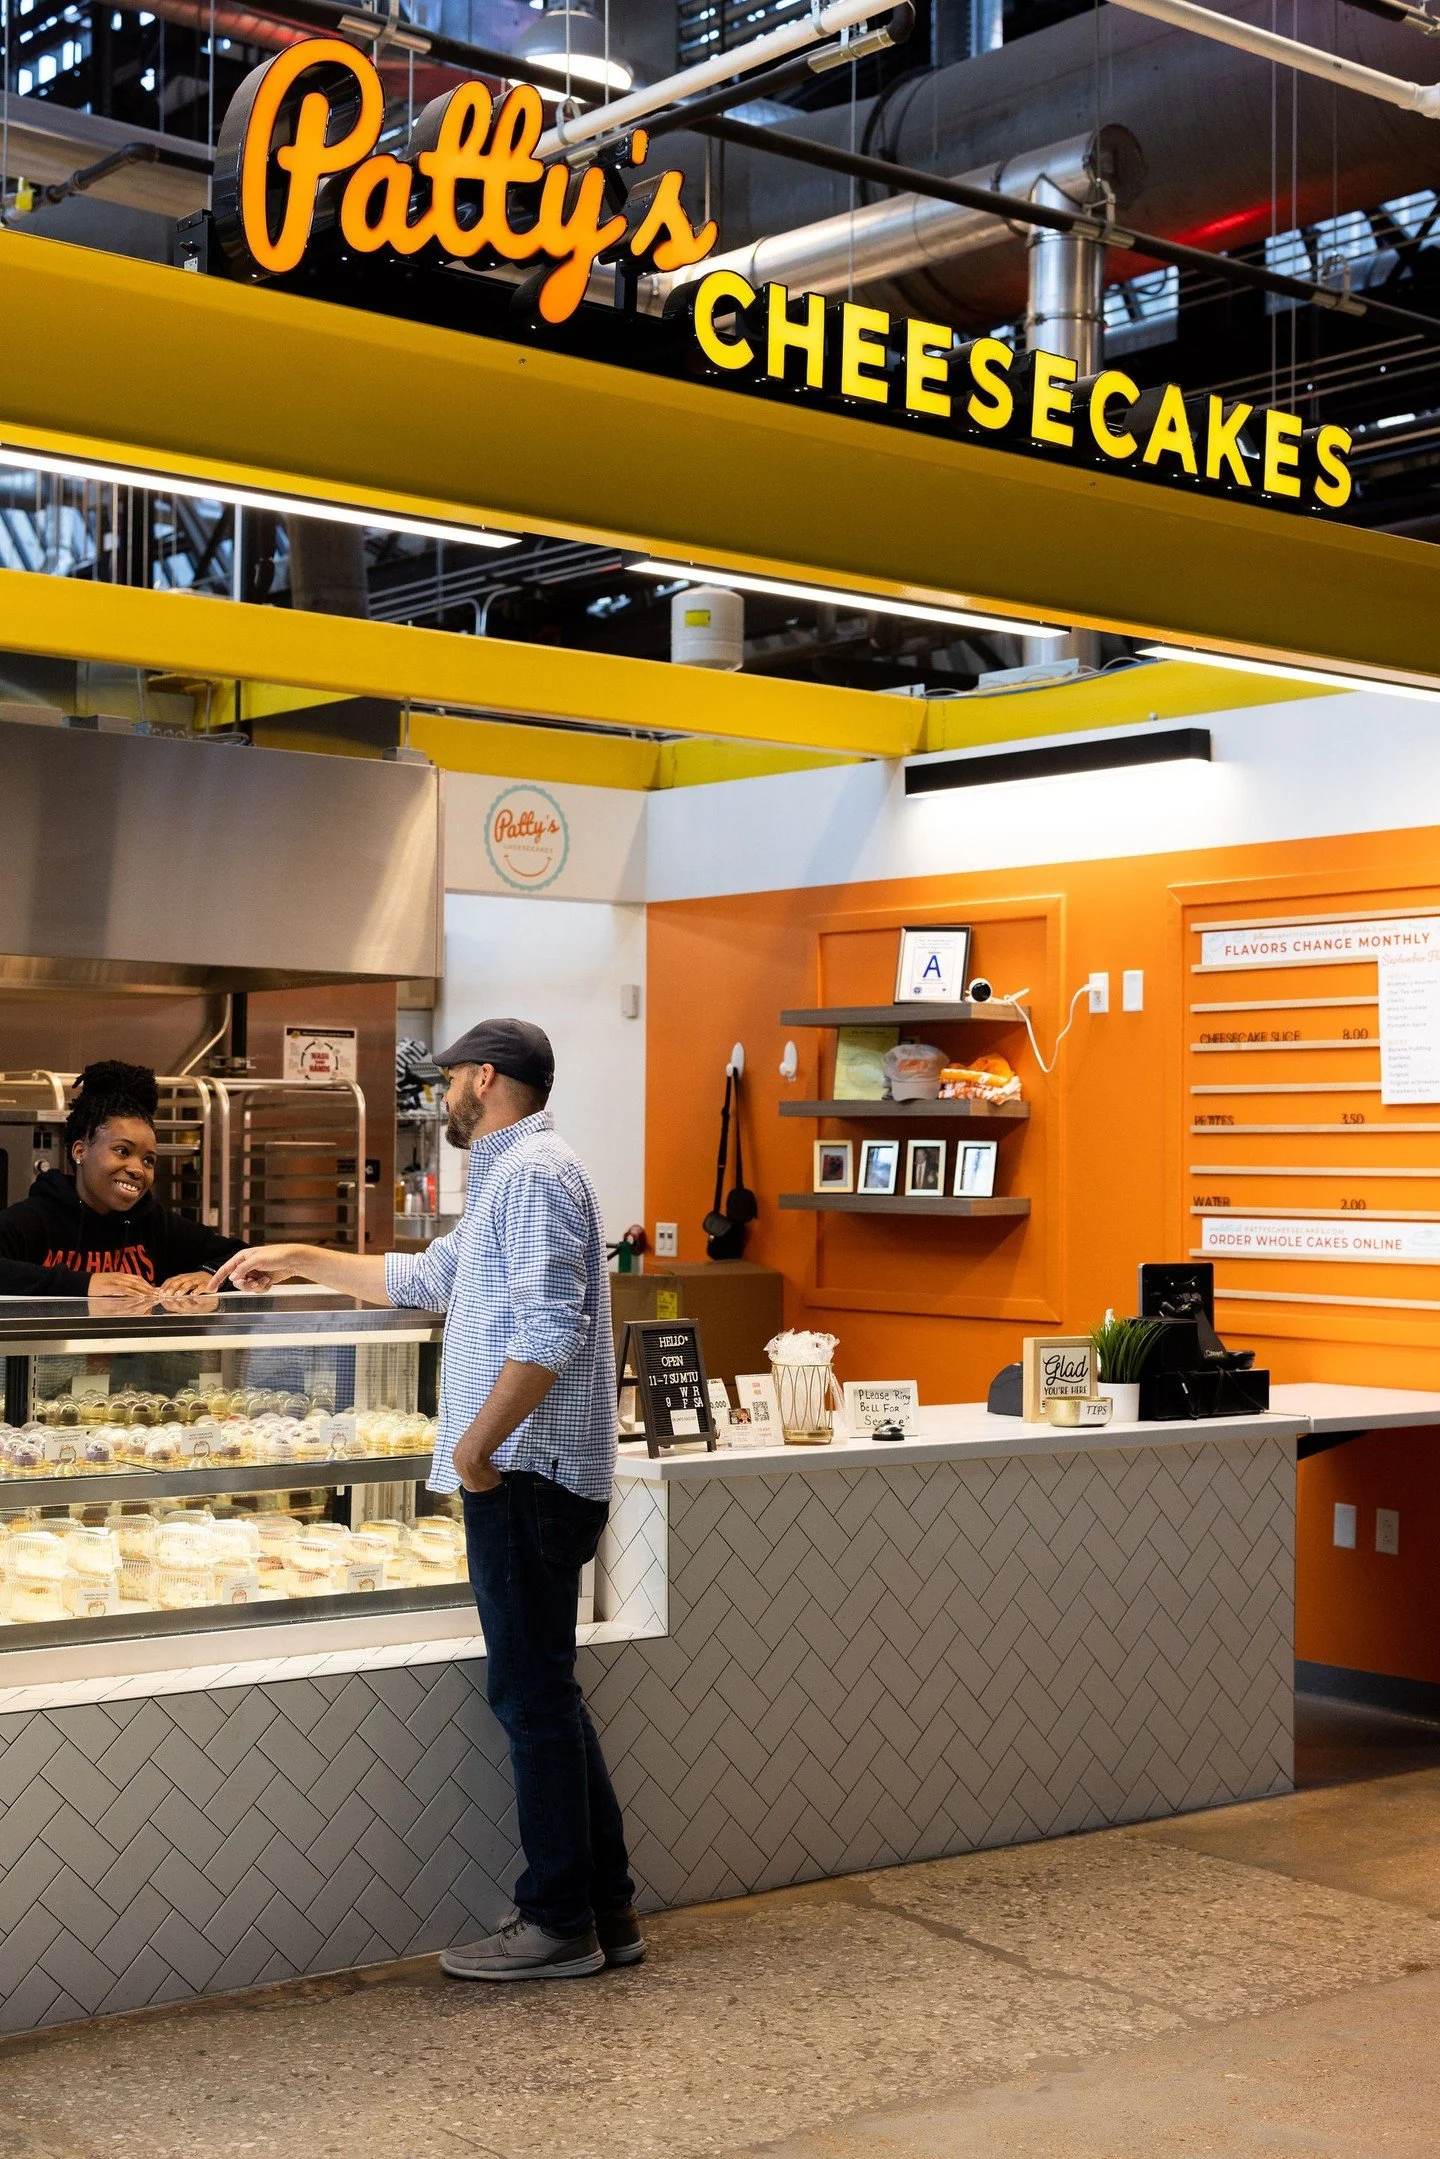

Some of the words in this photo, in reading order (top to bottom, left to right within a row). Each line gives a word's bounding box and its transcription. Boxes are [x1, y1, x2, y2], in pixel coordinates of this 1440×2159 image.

[241, 36, 719, 325] Patty's
[693, 268, 1353, 509] CHEESECAKES
[494, 808, 560, 844] Patty's
[1224, 942, 1288, 957] FLAVORS
[1293, 937, 1352, 952] CHANGE
[1358, 933, 1430, 948] MONTHLY
[922, 955, 942, 978] A
[1200, 1031, 1267, 1044] CHEESECAKE
[1270, 1030, 1302, 1042] SLICE
[1343, 1028, 1369, 1040] 8.00
[1194, 1115, 1235, 1126] PETITES
[1341, 1113, 1365, 1125] 3.50
[1193, 1195, 1231, 1207] WATER
[1340, 1198, 1366, 1211] 2.00
[1209, 1233, 1252, 1245] ORDER
[1256, 1235, 1302, 1247] WHOLE
[1306, 1236, 1349, 1249] CAKES
[1354, 1238, 1403, 1250] ONLINE
[658, 1335, 685, 1348] HELLO
[661, 1355, 684, 1367] OPEN
[1042, 1354, 1089, 1387] Glad
[648, 1374, 669, 1386] 11-7
[679, 1386, 689, 1398] W
[692, 1385, 701, 1397] R
[892, 1389, 911, 1406] Ring
[1043, 1386, 1069, 1396] YOU'RE
[1070, 1385, 1088, 1395] HERE
[665, 1397, 672, 1408] 9
[682, 1398, 689, 1409] F
[693, 1397, 704, 1408] SA
[1086, 1404, 1108, 1416] TIPS
